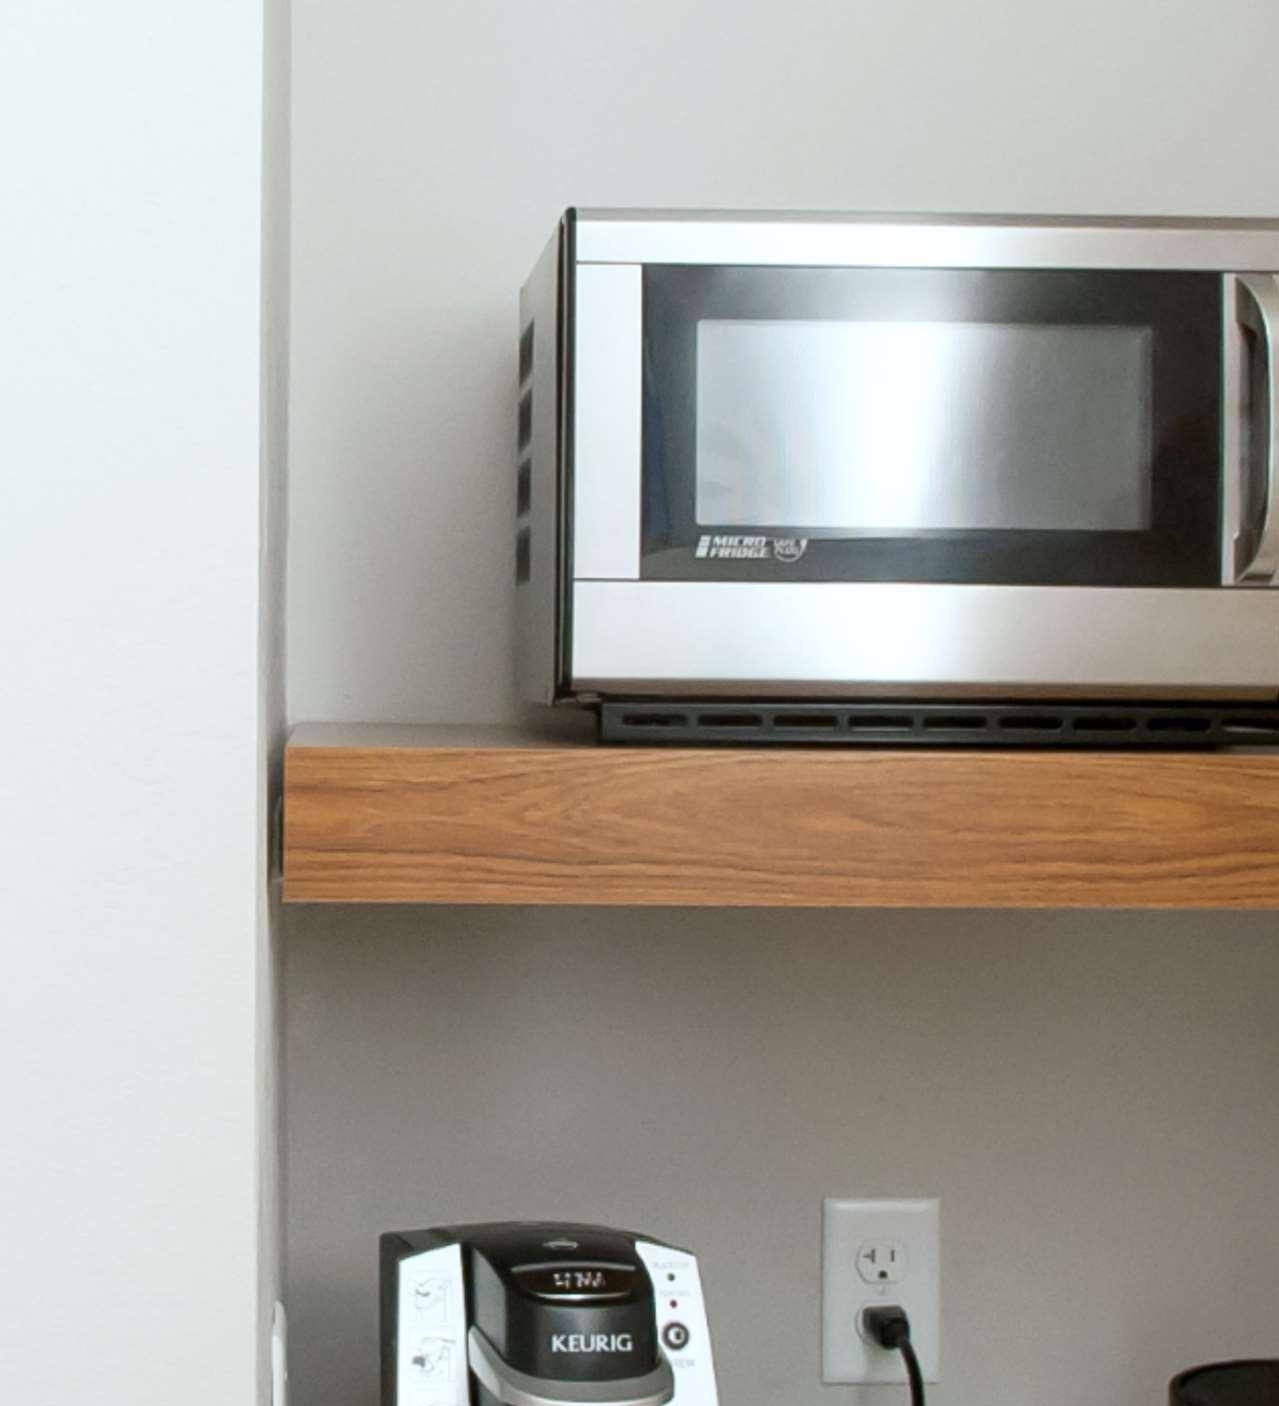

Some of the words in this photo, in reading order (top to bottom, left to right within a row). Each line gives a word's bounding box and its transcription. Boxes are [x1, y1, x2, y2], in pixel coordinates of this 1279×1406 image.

[712, 535, 767, 546] MICRO
[710, 546, 770, 558] FRIDGE
[551, 1334, 633, 1352] KEURIG
